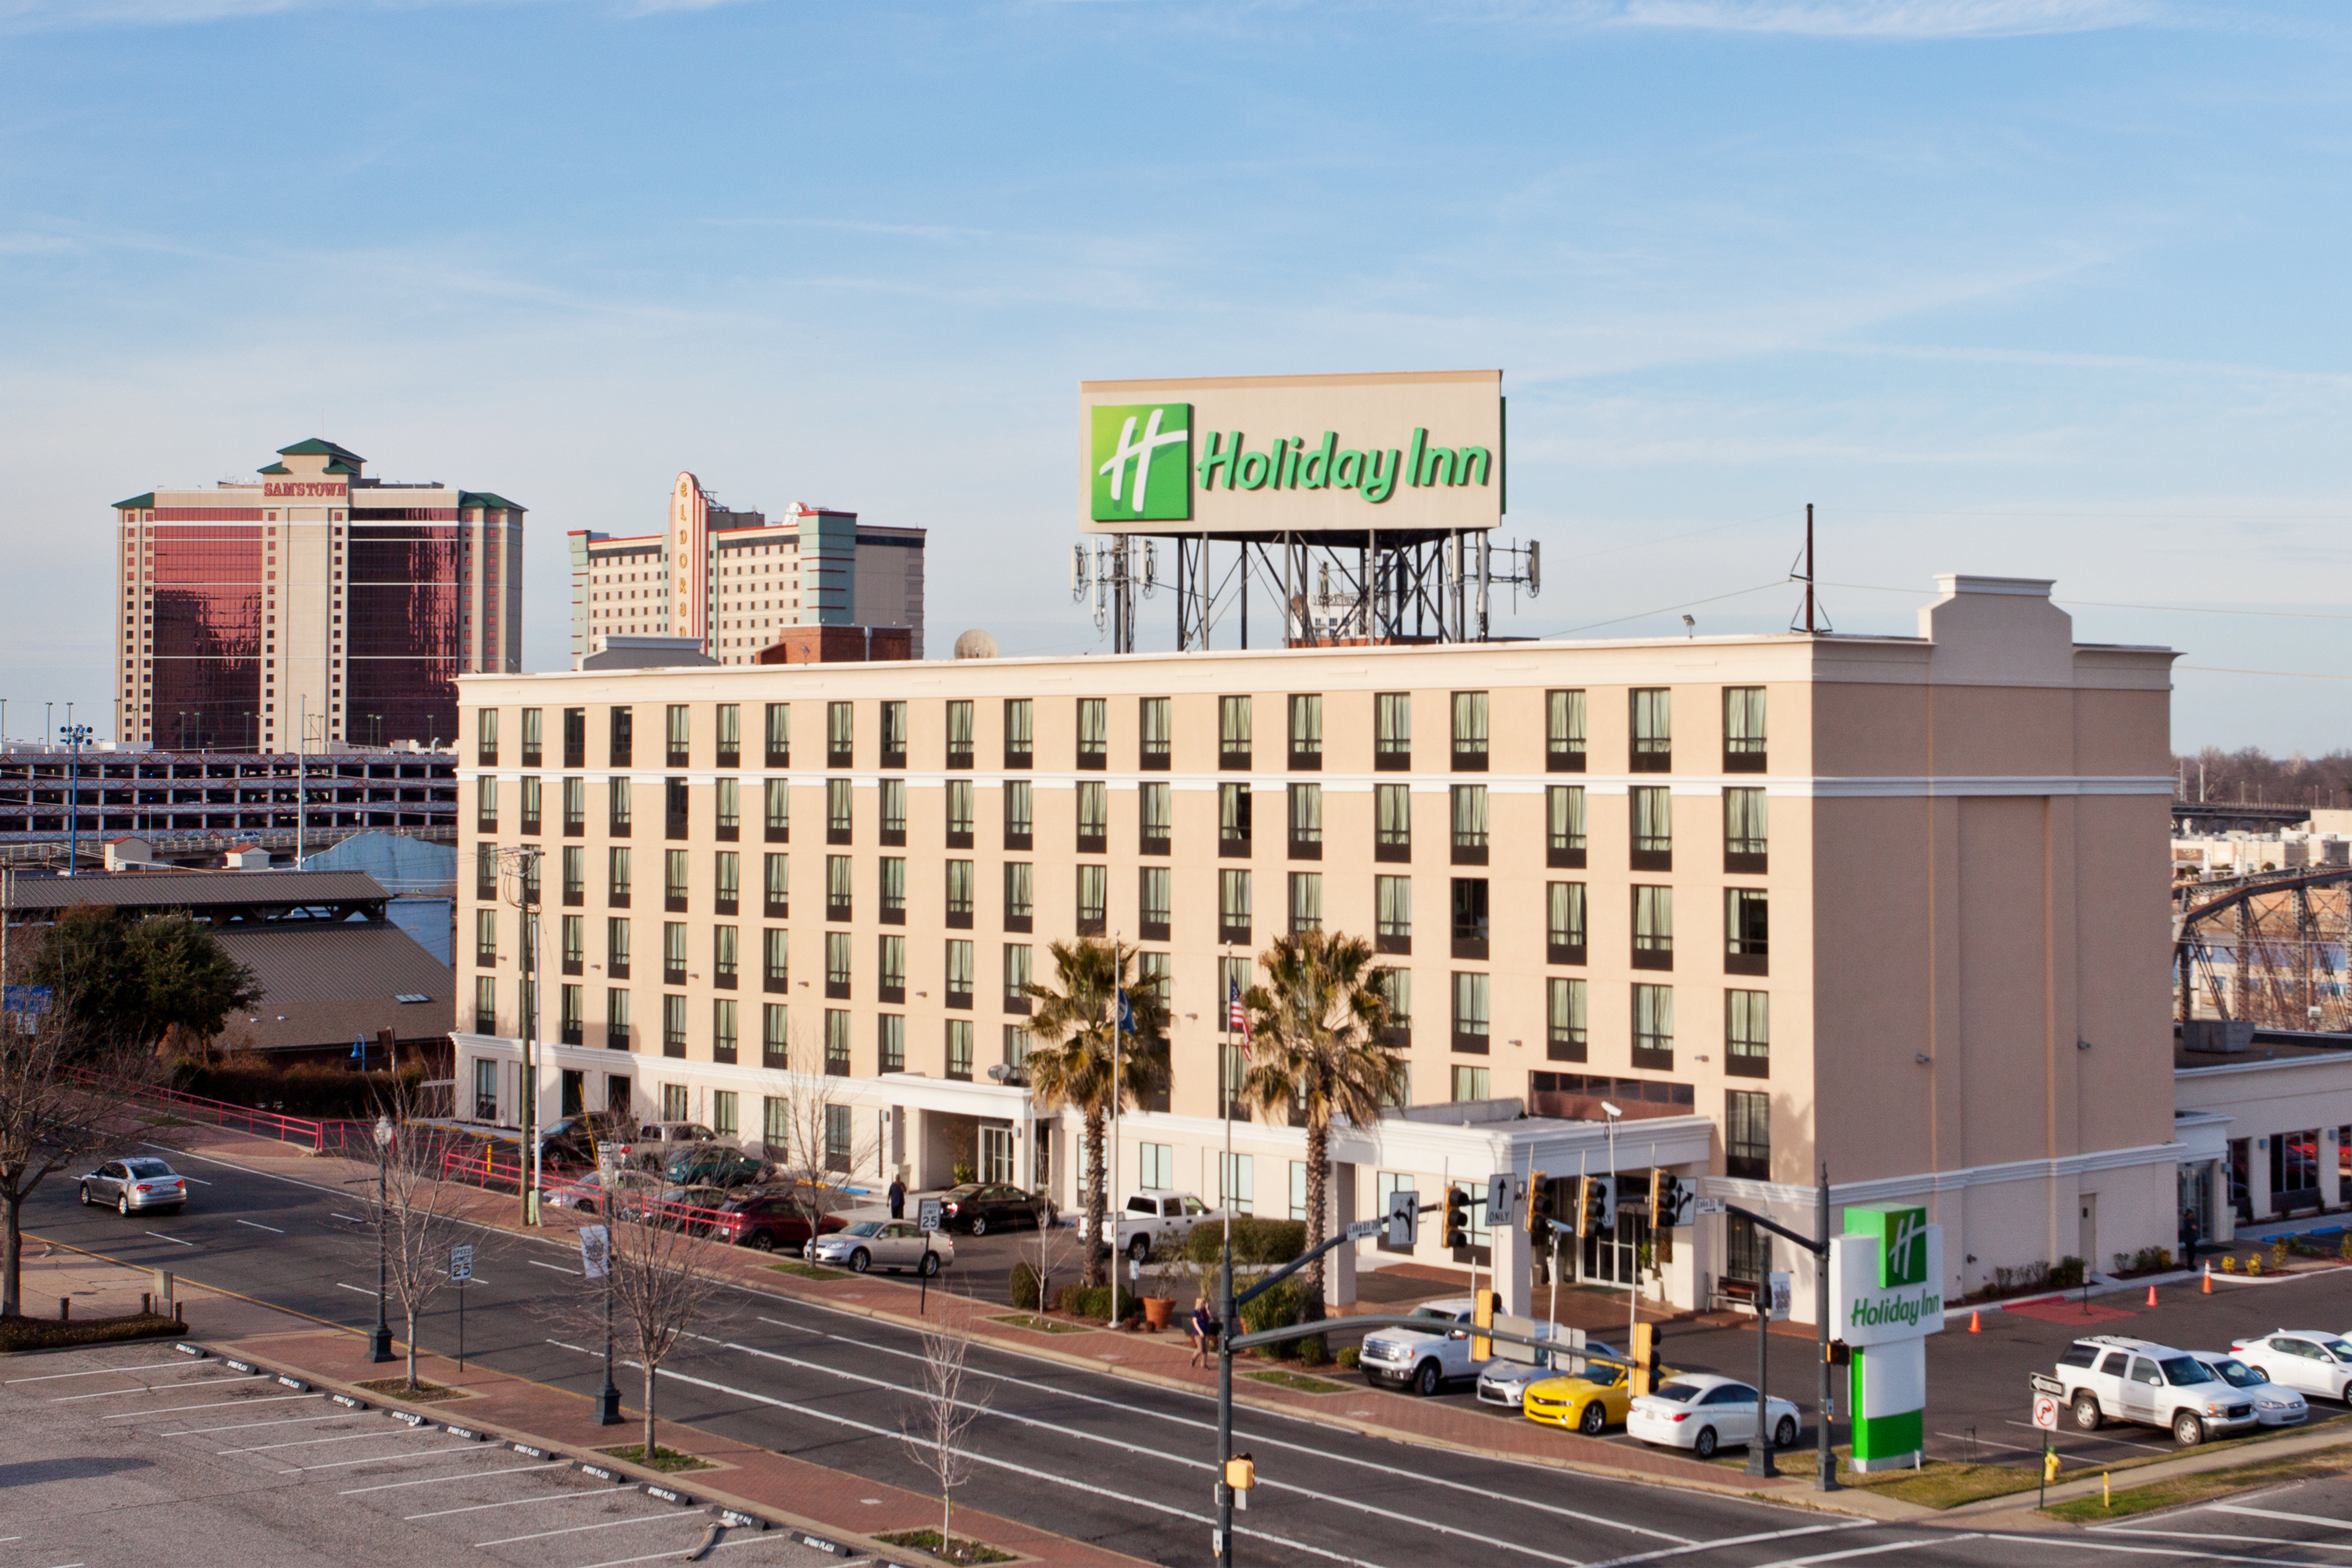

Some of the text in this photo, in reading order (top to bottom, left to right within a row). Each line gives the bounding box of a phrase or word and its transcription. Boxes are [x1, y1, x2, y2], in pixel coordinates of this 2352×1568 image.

[1196, 428, 1489, 502] Holiday Inn
[264, 482, 348, 497] SAM'S TOWN
[922, 1216, 937, 1228] 25
[1489, 1212, 1510, 1222] ONLY
[453, 1263, 470, 1277] 25
[1851, 1289, 1939, 1327] Holiday Inn
[819, 1541, 835, 1552] PLAZA
